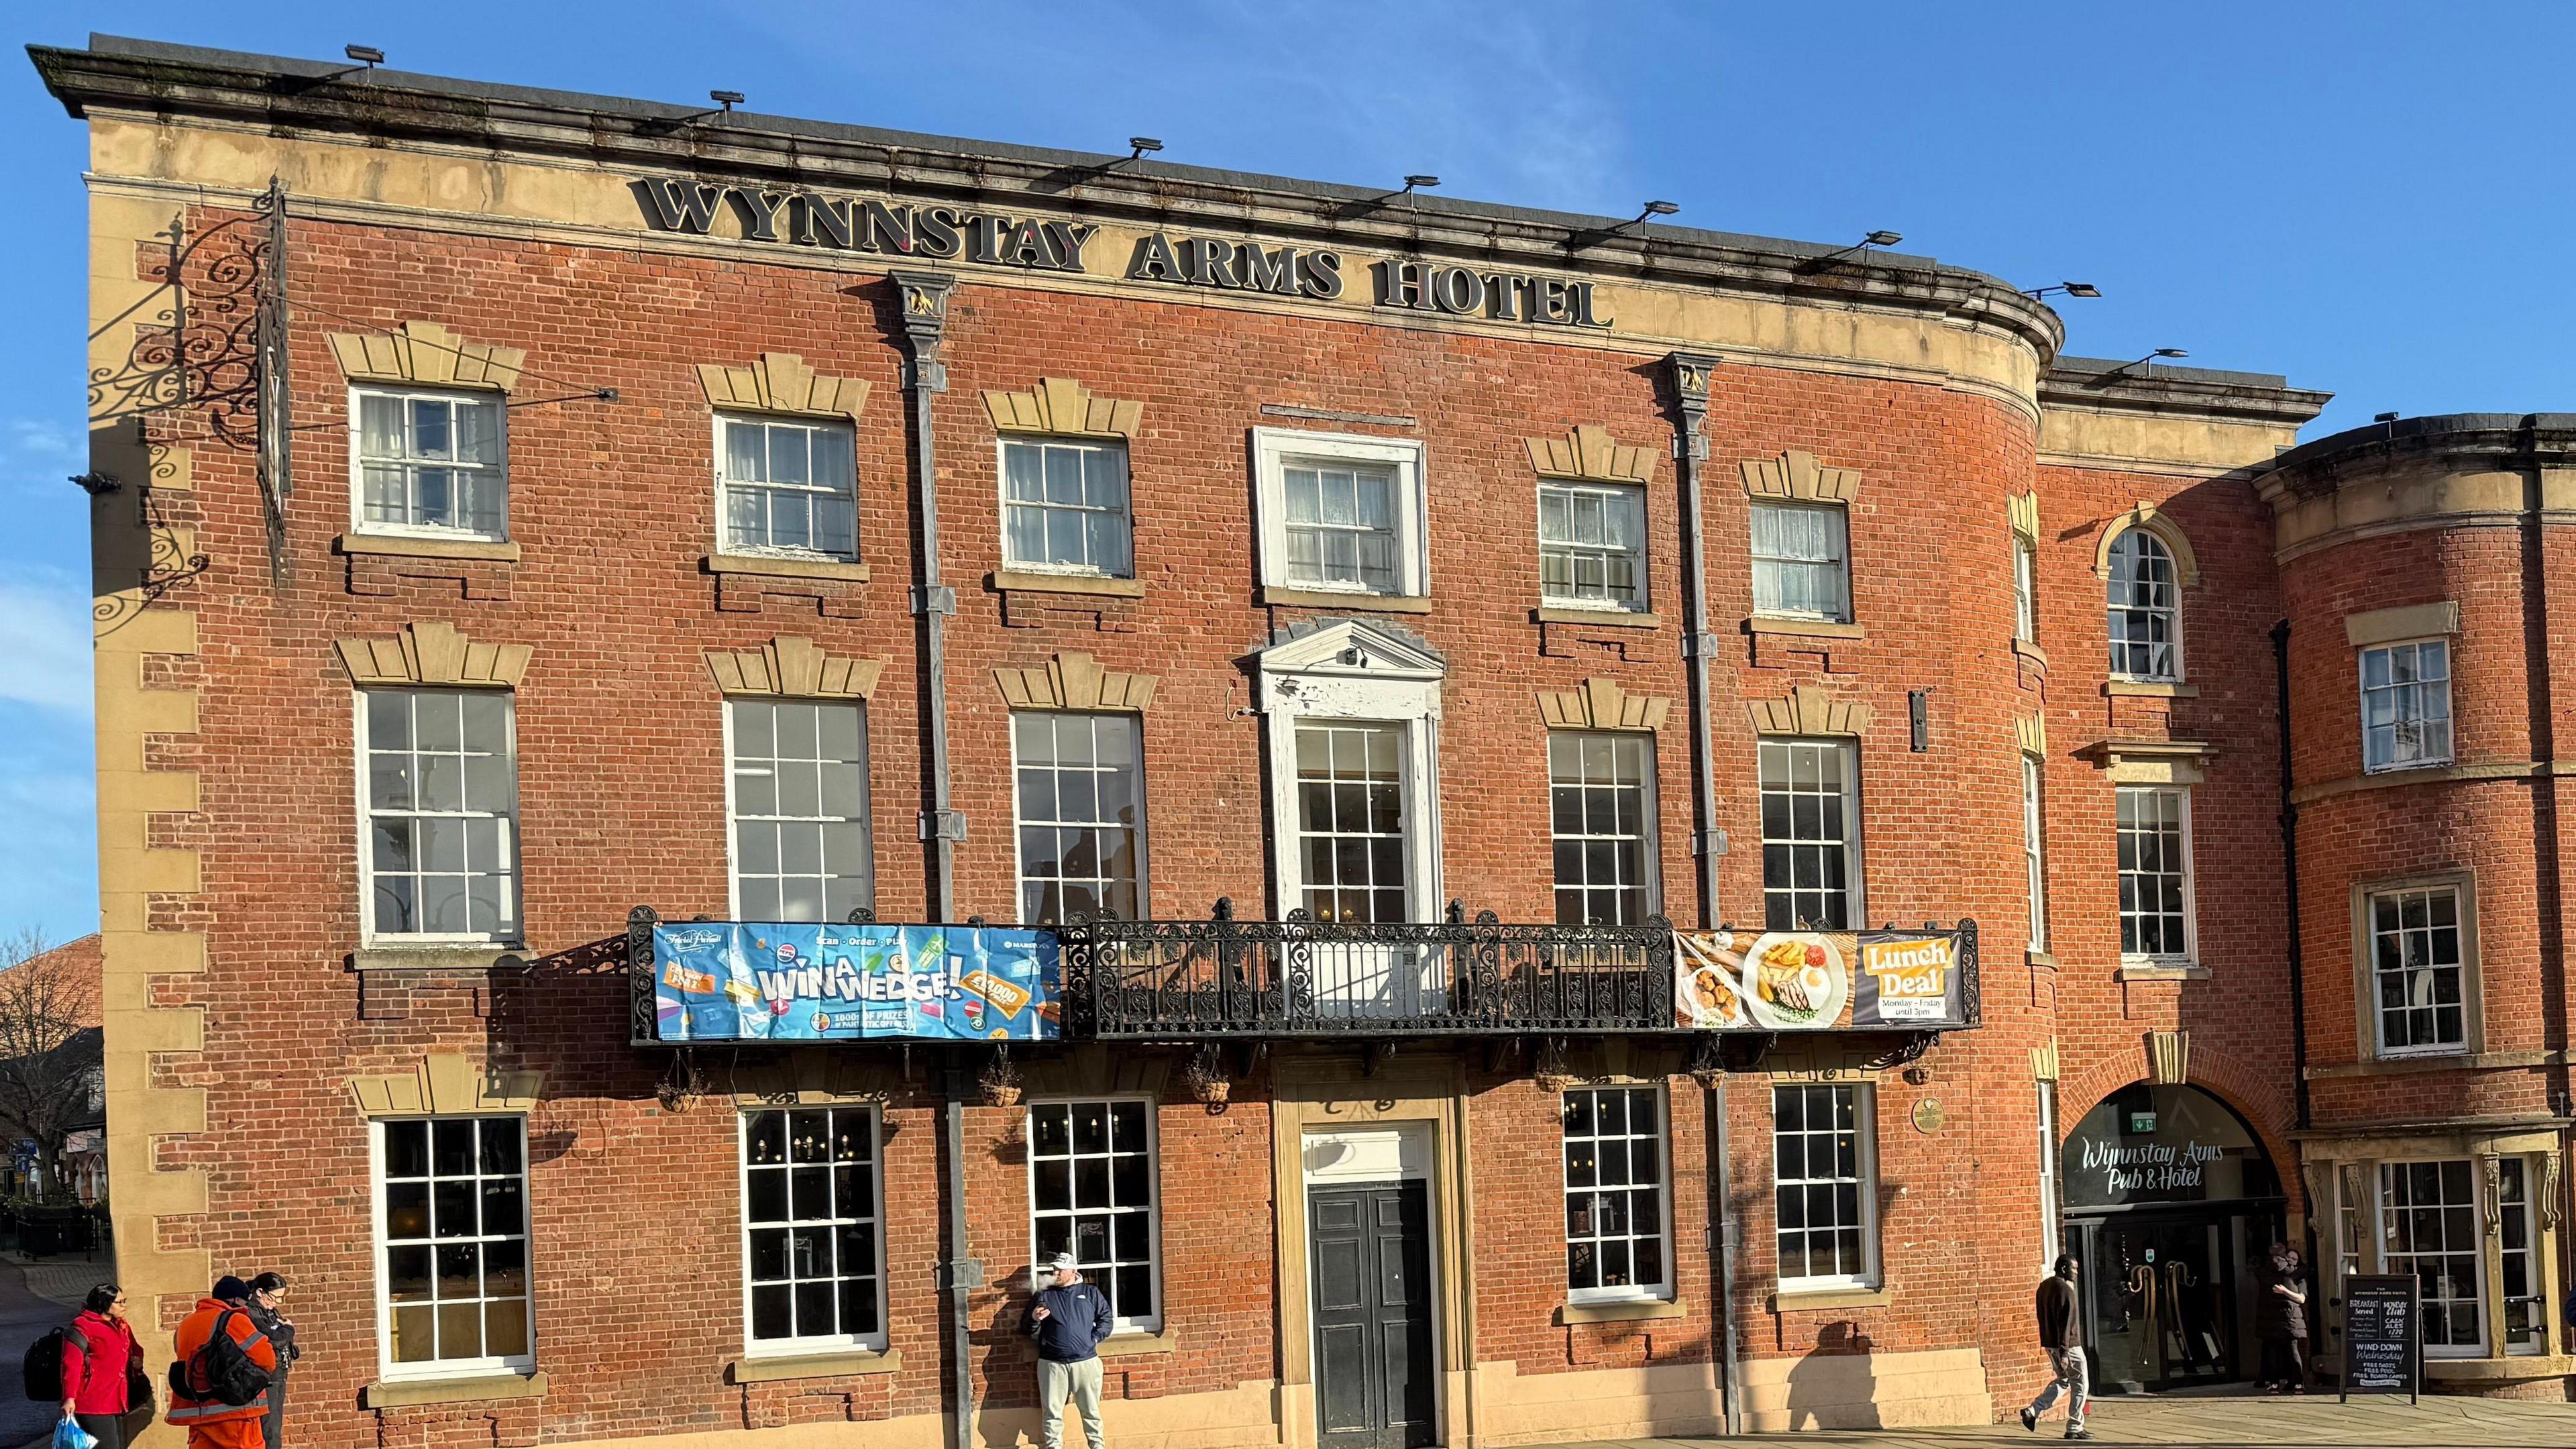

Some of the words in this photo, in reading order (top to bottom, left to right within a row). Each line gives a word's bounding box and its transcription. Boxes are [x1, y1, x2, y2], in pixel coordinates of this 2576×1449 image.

[642, 176, 1102, 272] WYNNSTAY
[1134, 231, 1346, 300] ARMS
[1381, 258, 1615, 329] HOTEL
[816, 936, 839, 946] Scan
[848, 937, 877, 946] Order
[1869, 943, 1948, 969] Lunch
[835, 957, 856, 977] A
[757, 958, 837, 1001] WIN
[835, 955, 962, 1002] WEDGE!
[1884, 969, 1937, 996] Deal
[1882, 1000, 1913, 1008] Monday
[1919, 999, 1942, 1008] Friday
[1896, 1008, 1912, 1016] until
[1914, 1008, 1930, 1016] 3pm
[876, 1010, 908, 1020] PRIZES
[2082, 1136, 2176, 1173] Wynnstay
[2179, 1140, 2224, 1167] Arms
[2108, 1168, 2143, 1195] Pub
[2147, 1169, 2157, 1189] &
[2157, 1166, 2202, 1191] Hotel
[2386, 1307, 2406, 1316] Club
[2356, 1343, 2379, 1351] WIND
[2356, 1350, 2404, 1364] Wednesday
